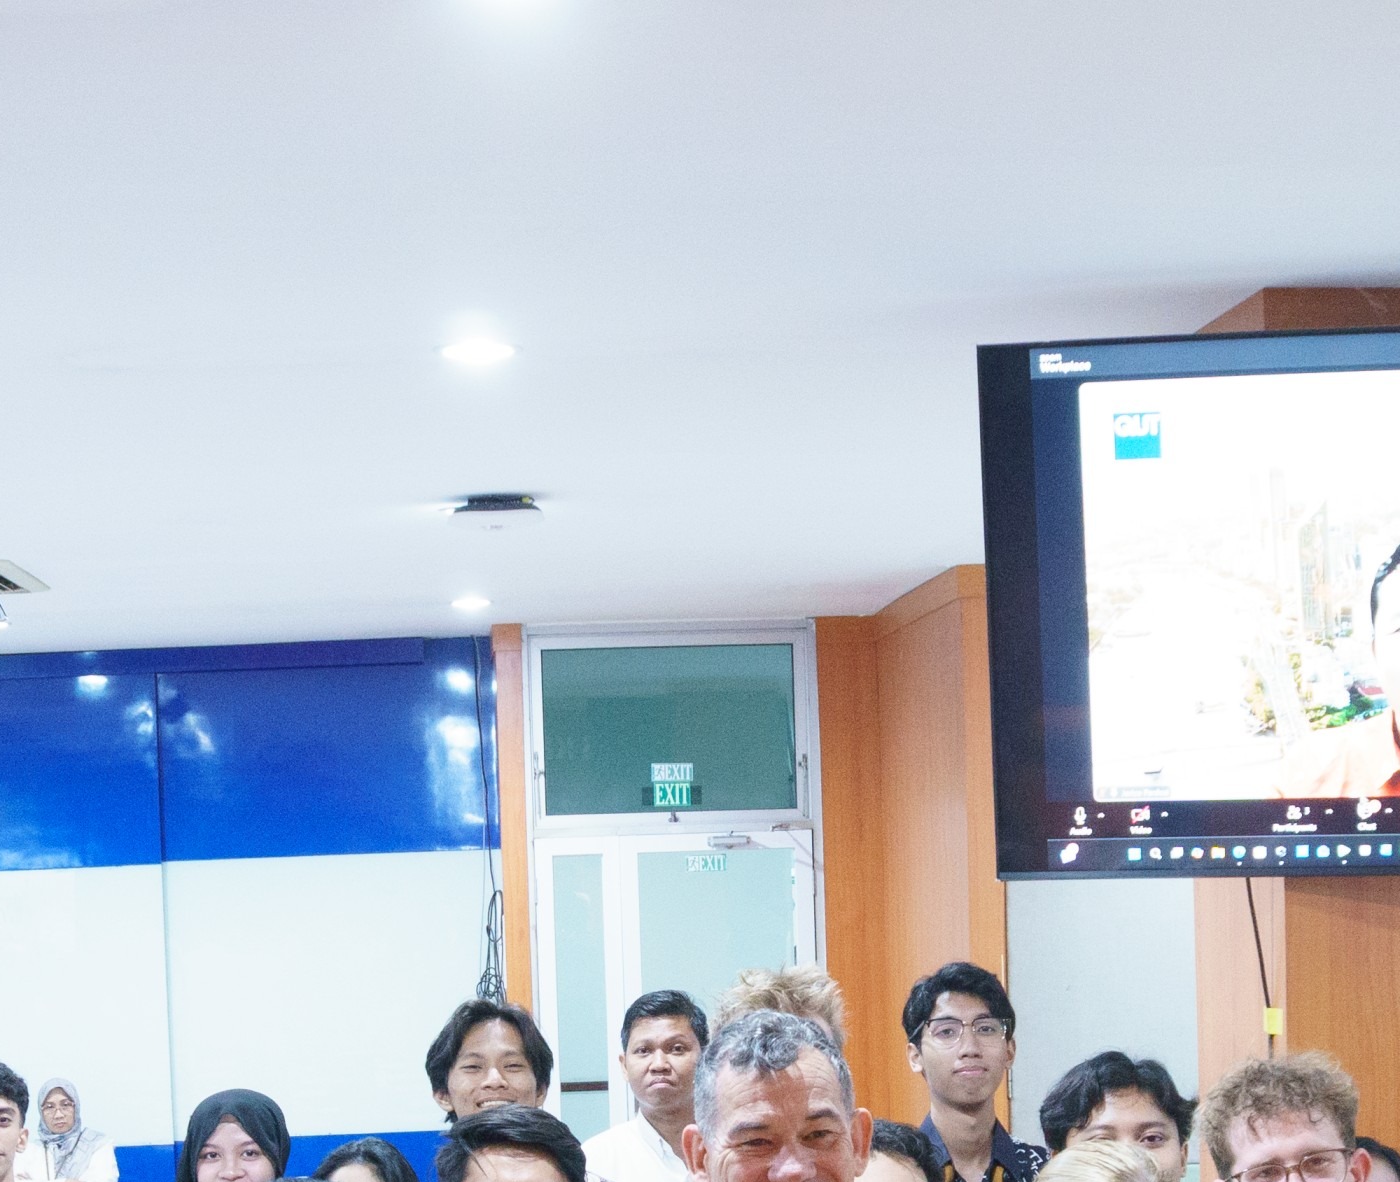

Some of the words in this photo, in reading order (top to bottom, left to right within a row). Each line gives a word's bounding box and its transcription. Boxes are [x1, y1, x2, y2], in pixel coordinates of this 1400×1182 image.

[1114, 414, 1160, 437] QUT
[665, 764, 691, 780] EXIT
[655, 783, 690, 805] EXIT
[699, 855, 724, 871] EXIT
